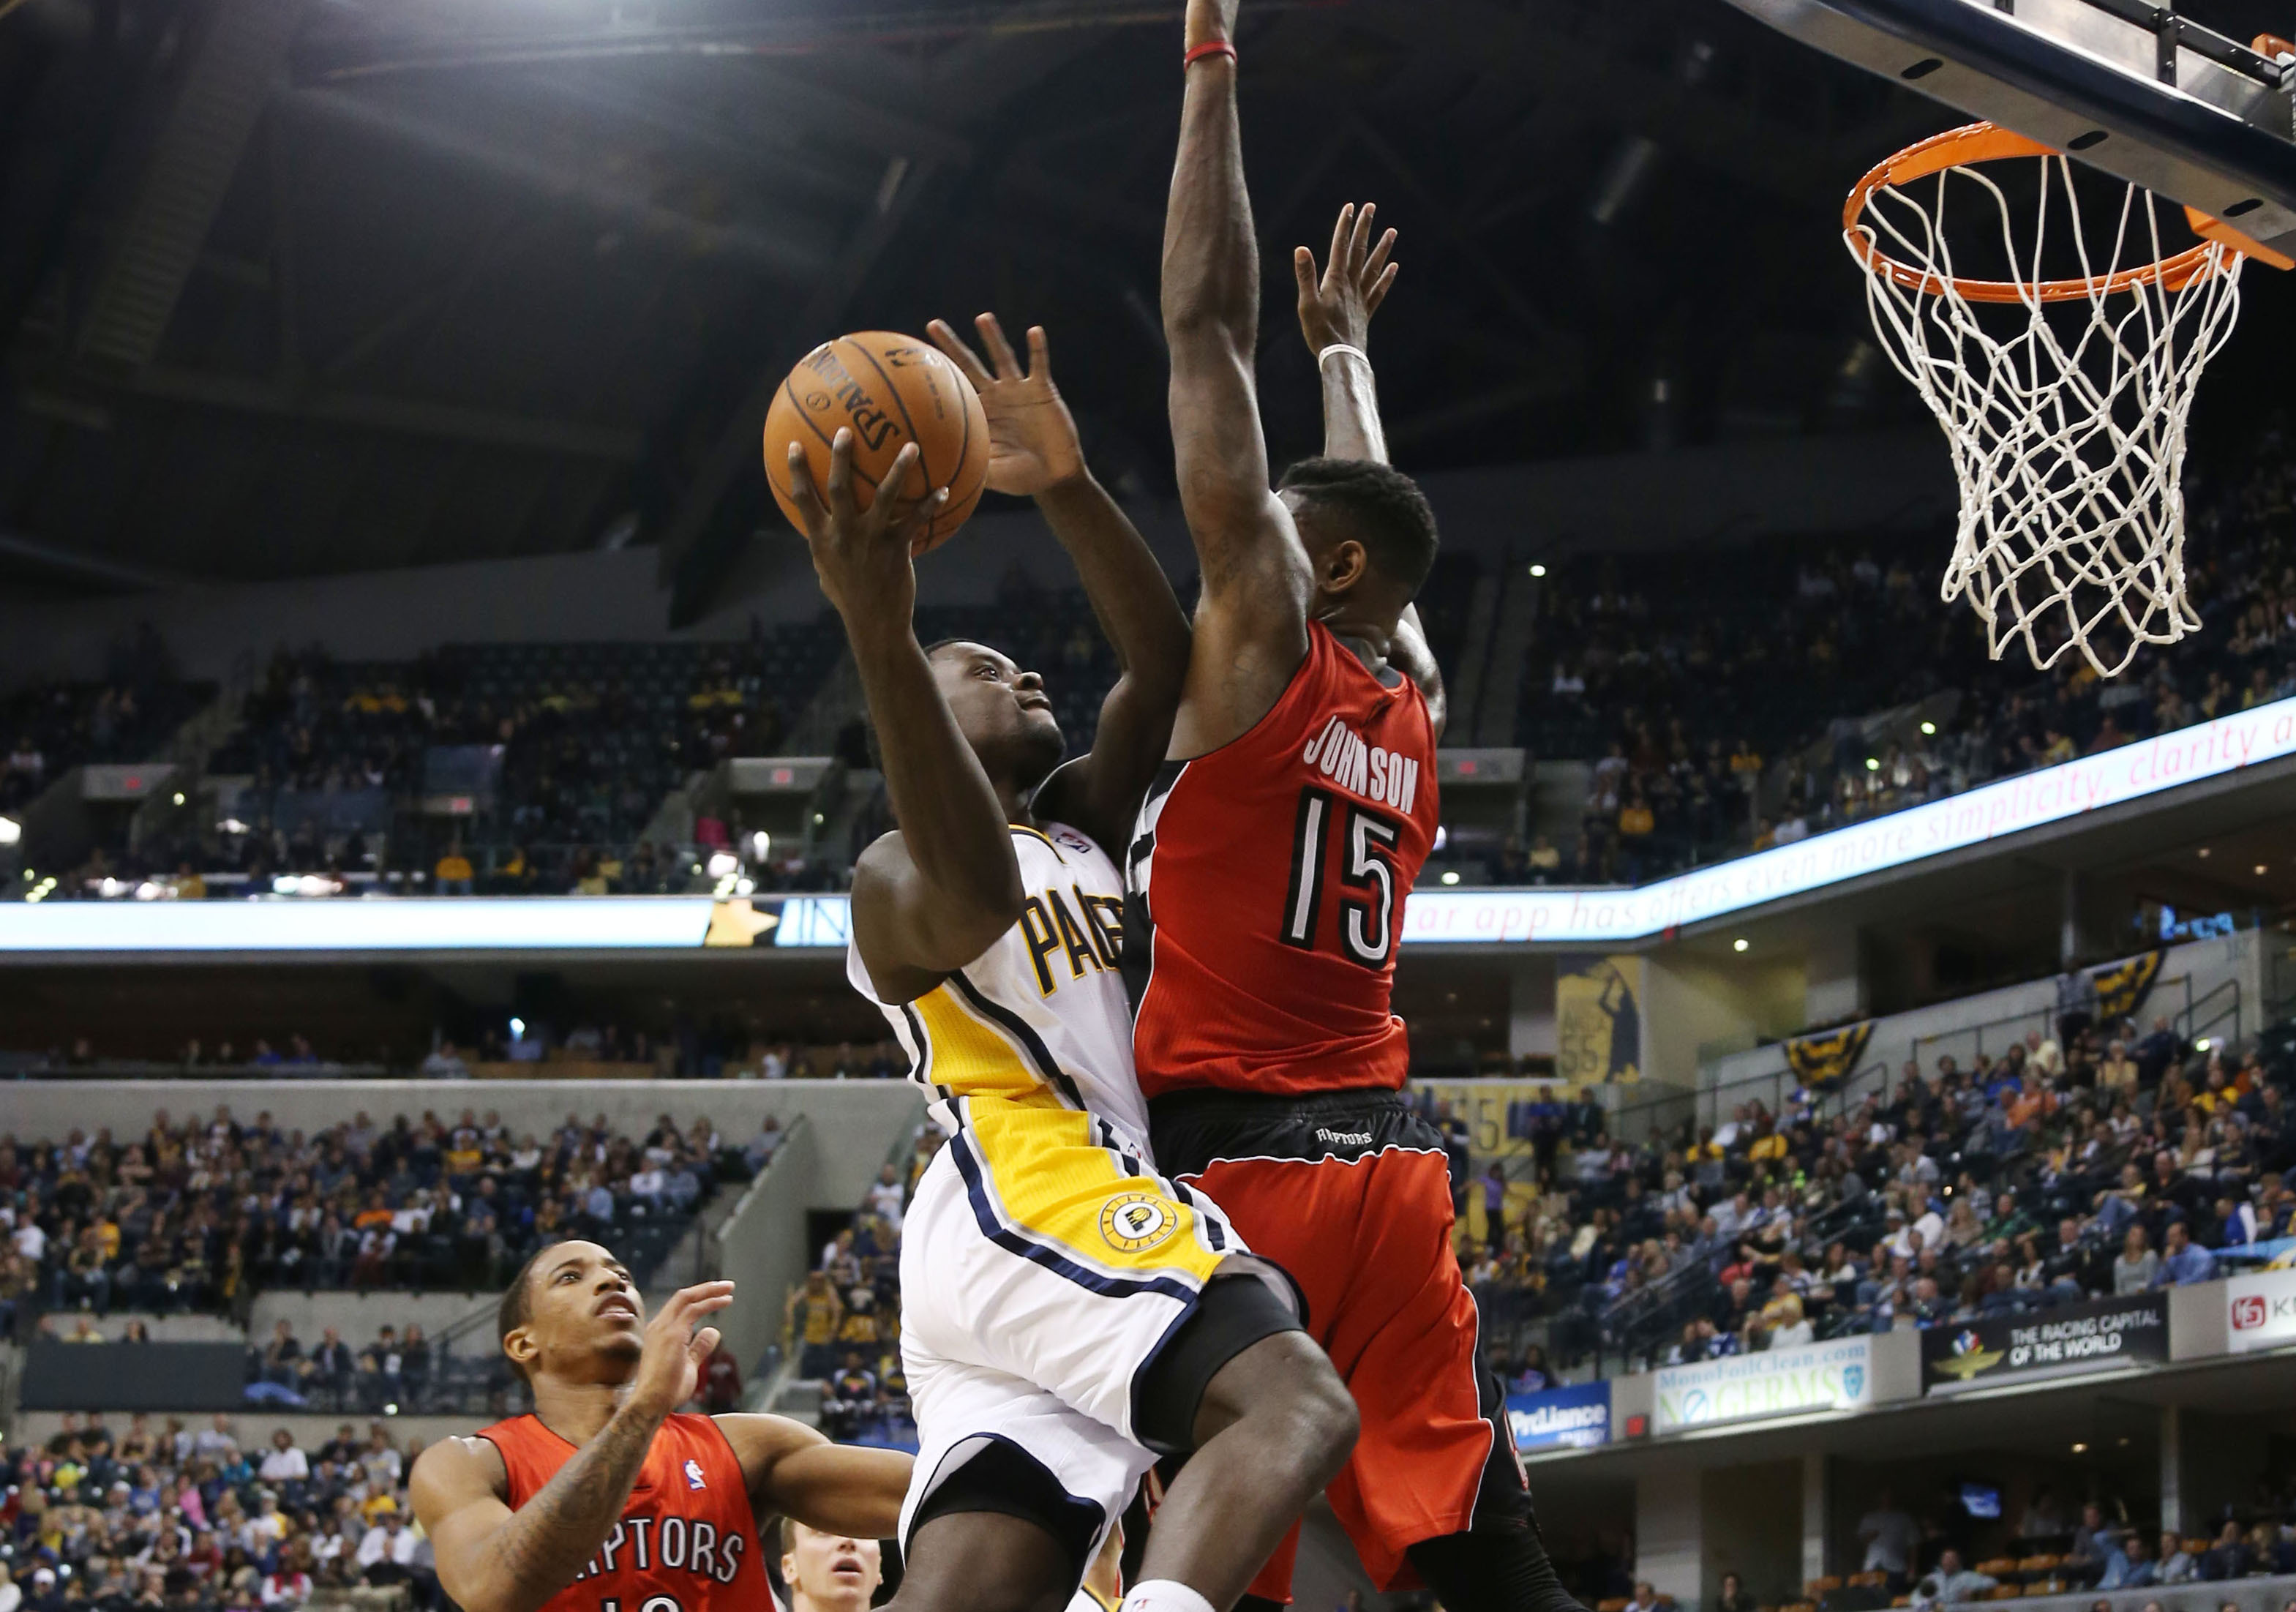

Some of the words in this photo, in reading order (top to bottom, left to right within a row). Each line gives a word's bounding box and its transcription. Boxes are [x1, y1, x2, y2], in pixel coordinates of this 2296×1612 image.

[1303, 714, 1418, 815] JOHNSON
[1475, 905, 1550, 941] app
[1569, 893, 1636, 930] has
[1648, 877, 1732, 929] offers
[1745, 850, 1817, 896] even
[1831, 828, 1913, 871] more
[1927, 763, 2112, 844] simplicity,
[2129, 719, 2259, 785] clarity
[1285, 792, 1397, 965] 15
[1315, 1128, 1373, 1145] RAPTORS
[2011, 1326, 2039, 1346] THE
[2041, 1317, 2097, 1341] RACING
[2098, 1309, 2161, 1333] CAPITAL
[2273, 1295, 2296, 1317] K
[2009, 1345, 2032, 1367] OF
[2033, 1340, 2063, 1362] THE
[2064, 1332, 2122, 1359] WORLD
[1716, 1365, 1839, 1416] GERMS
[577, 1516, 744, 1584] PTORS
